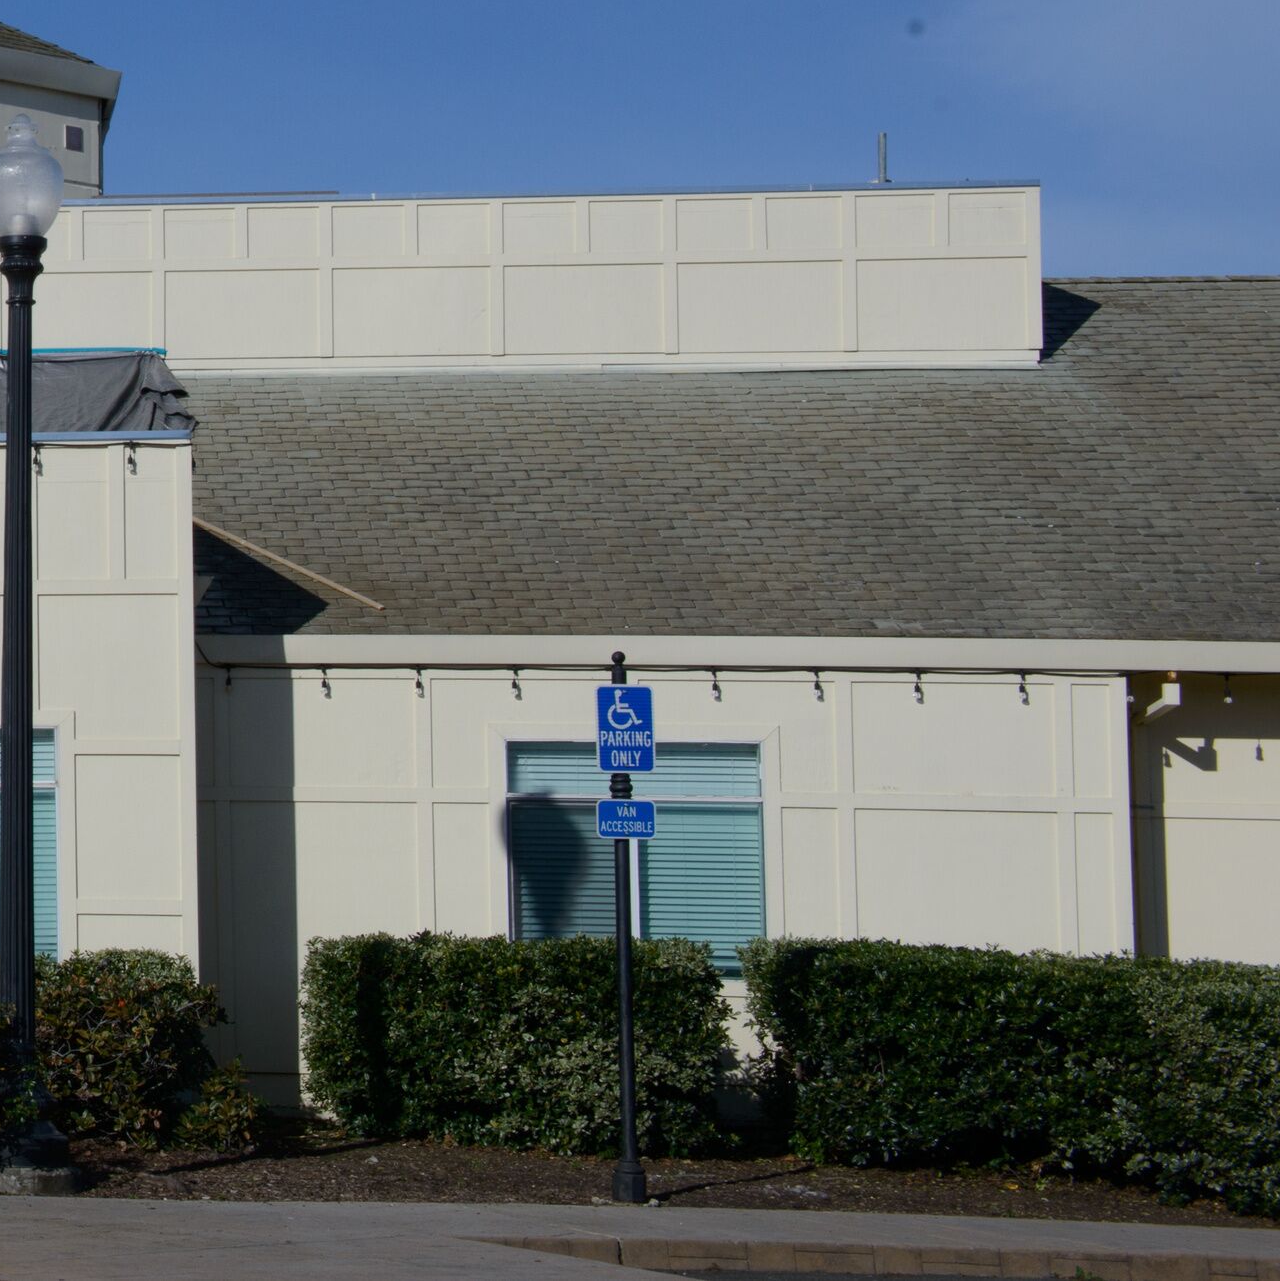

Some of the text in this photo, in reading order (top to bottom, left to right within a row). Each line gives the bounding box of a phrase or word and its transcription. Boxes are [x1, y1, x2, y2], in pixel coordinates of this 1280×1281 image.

[600, 730, 652, 748] PARKING
[611, 750, 641, 767] ONLY
[617, 806, 637, 817] VAN
[600, 821, 653, 833] ACCESSIBLE
